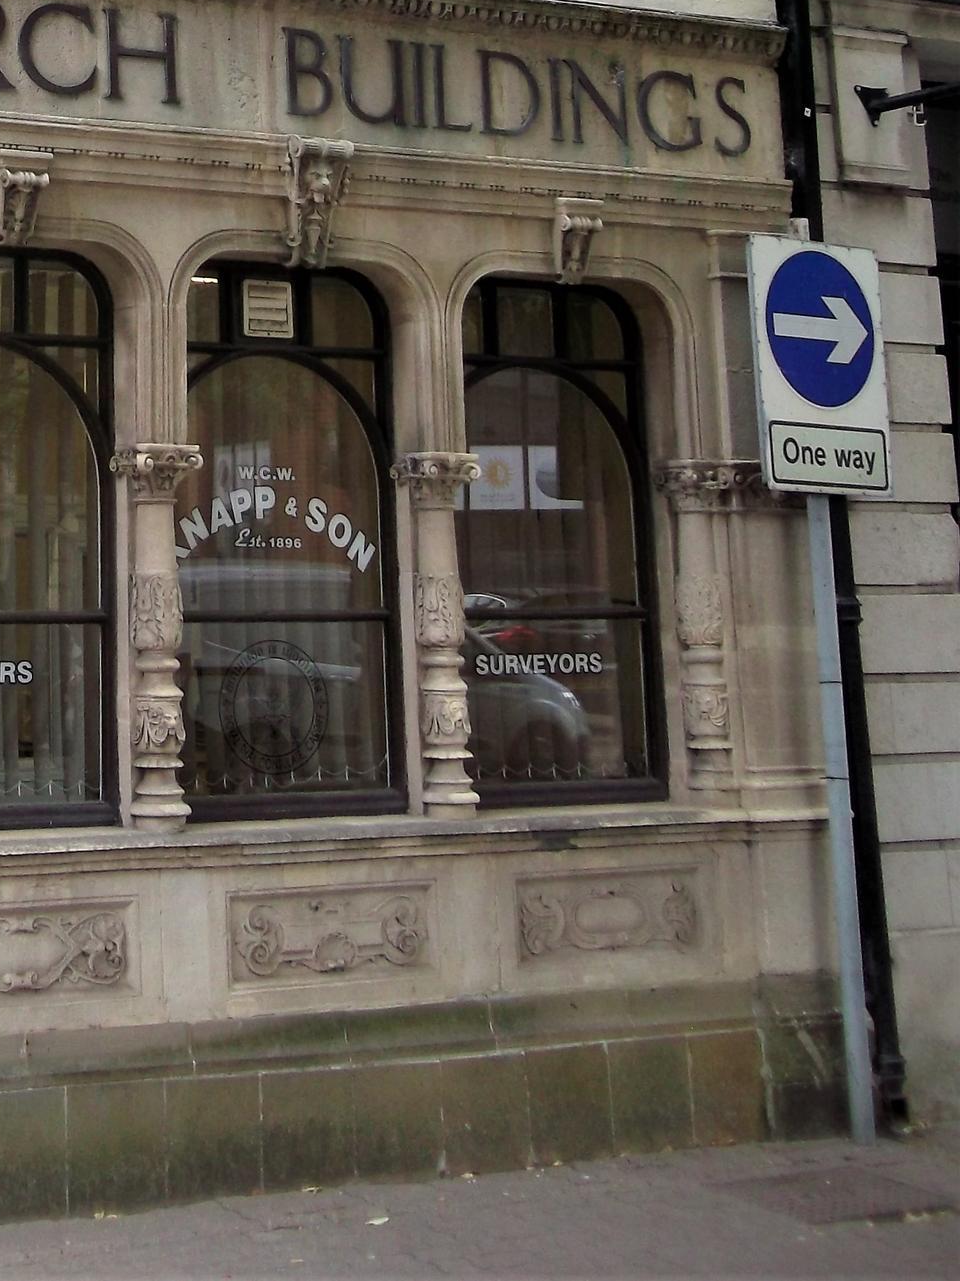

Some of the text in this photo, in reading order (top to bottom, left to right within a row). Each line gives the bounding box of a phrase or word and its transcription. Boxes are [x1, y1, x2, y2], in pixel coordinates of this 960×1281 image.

[281, 26, 754, 158] BUILDINGS
[783, 437, 876, 476] One way
[239, 466, 295, 481] W.C.W.
[235, 528, 302, 549] Est. 1896
[285, 497, 298, 517] &
[305, 498, 376, 572] SON
[475, 652, 602, 675] SURVEYORS
